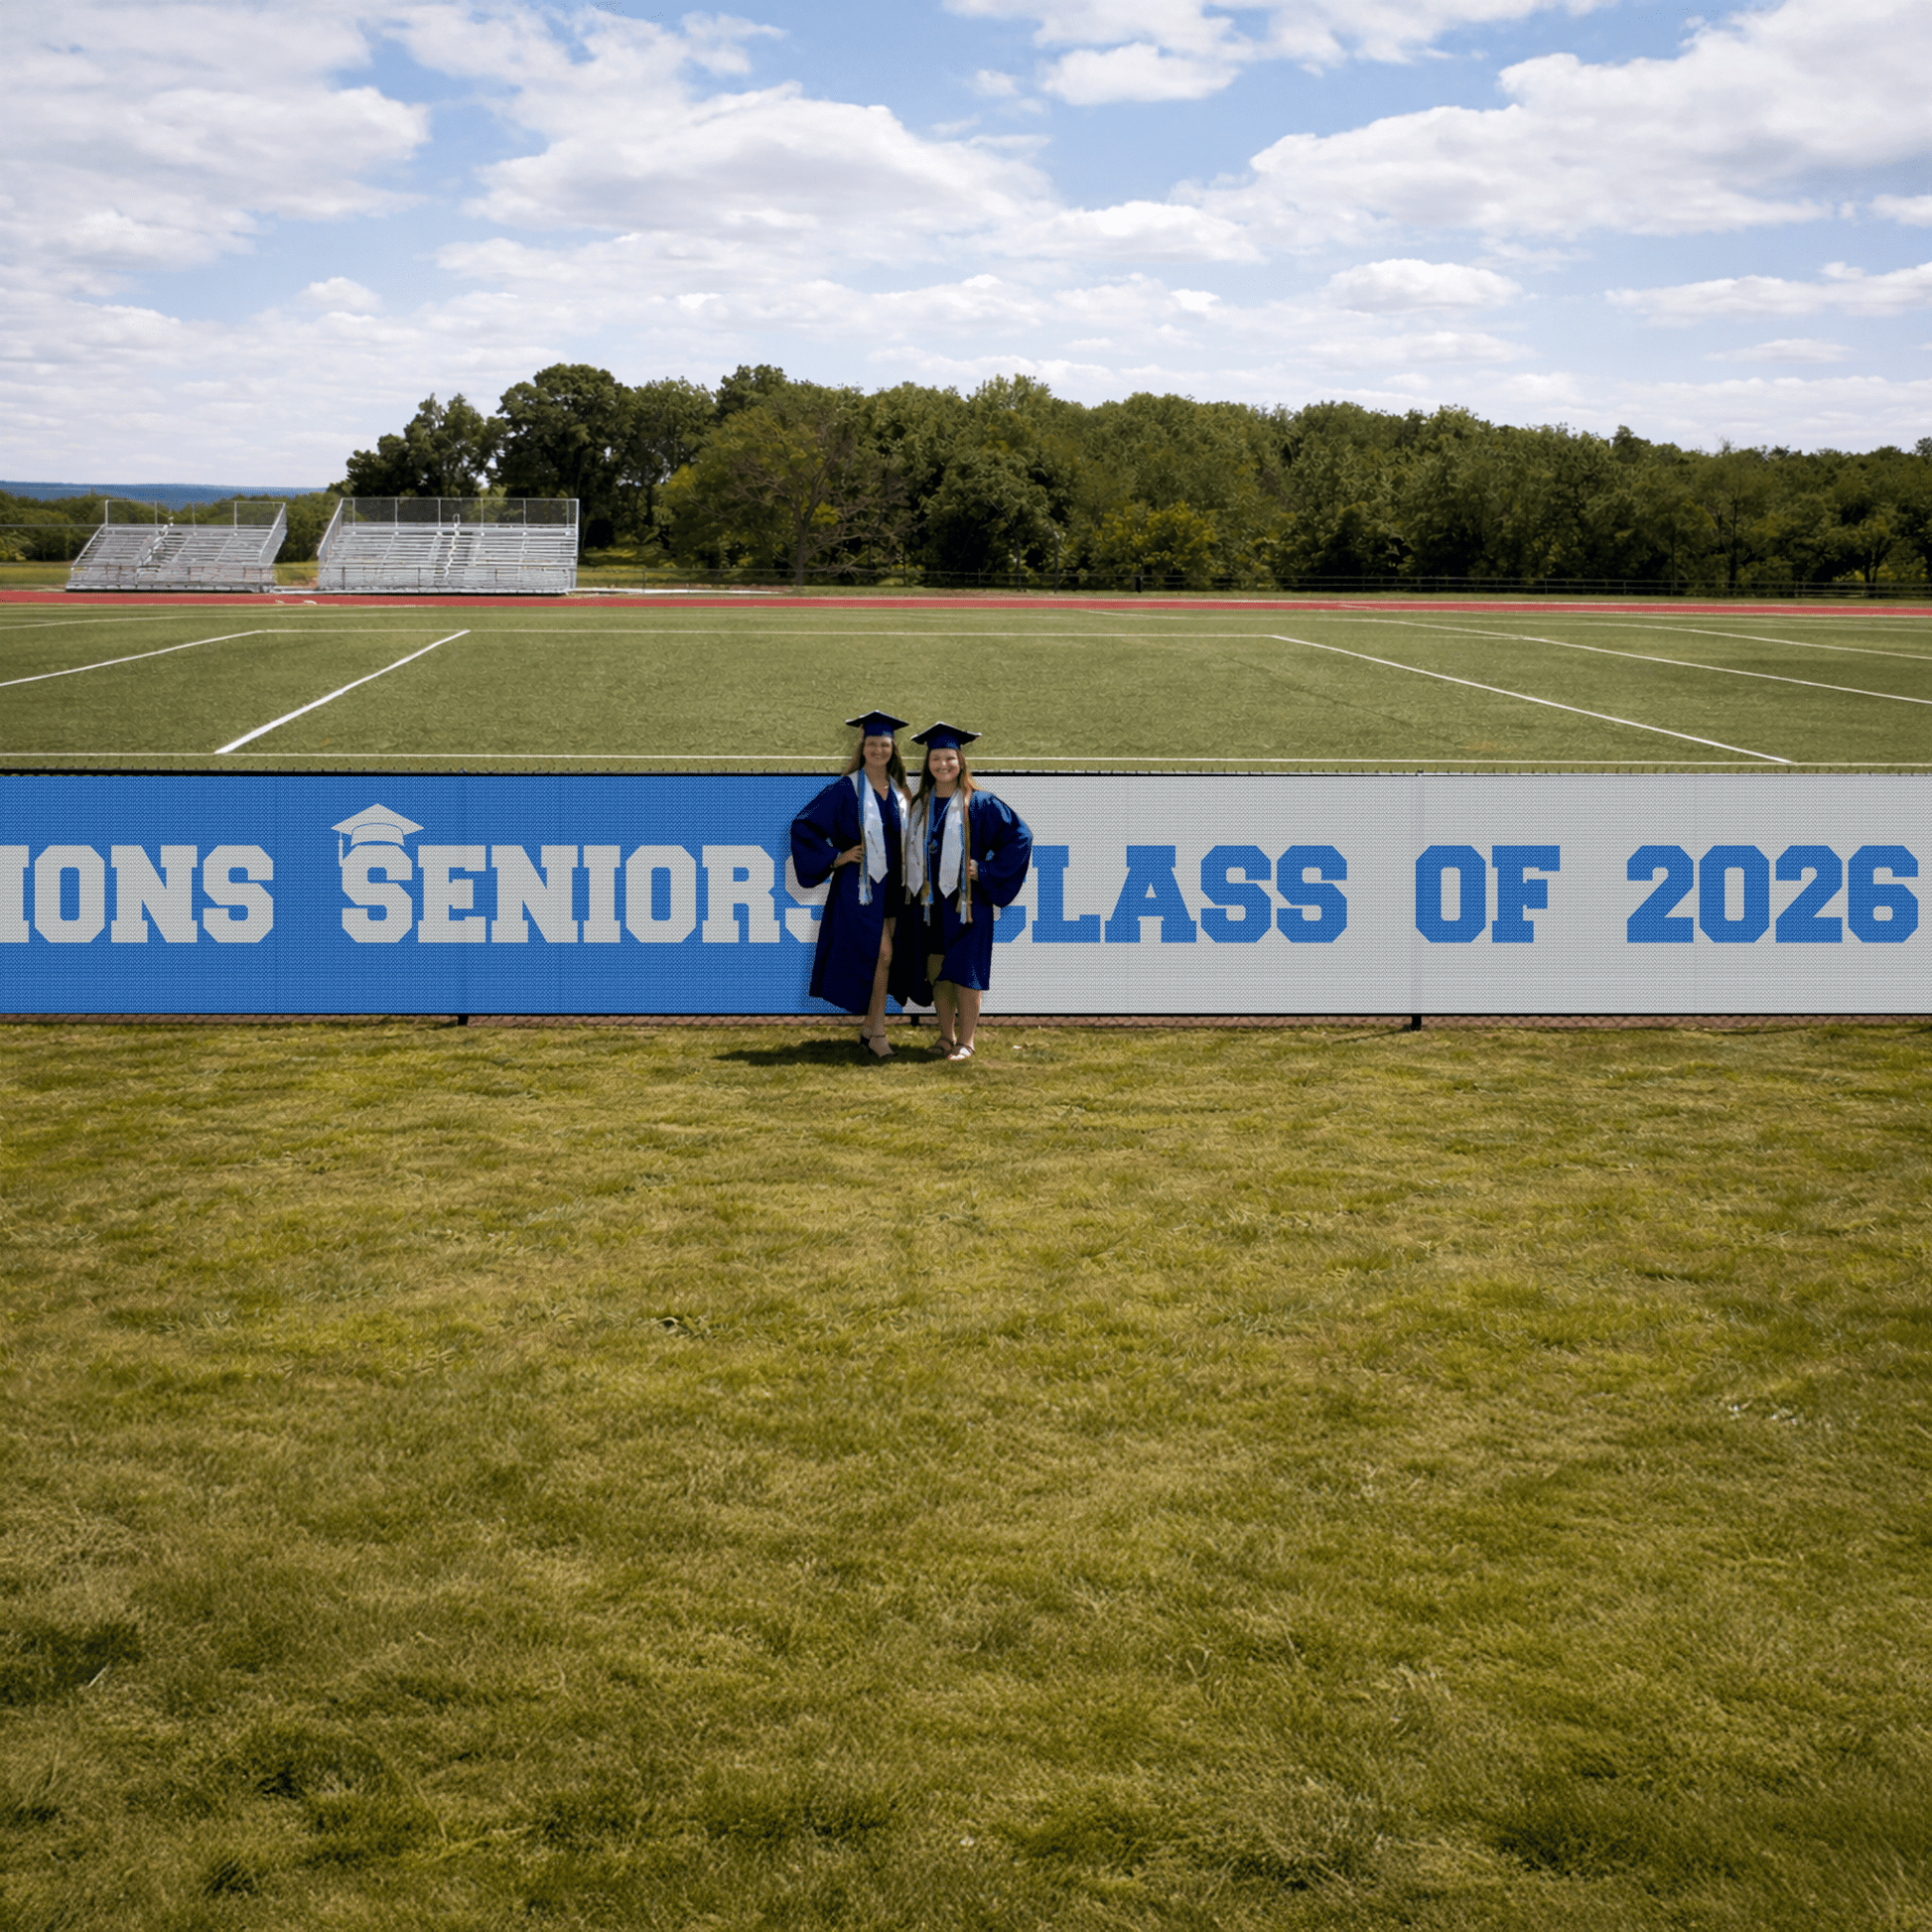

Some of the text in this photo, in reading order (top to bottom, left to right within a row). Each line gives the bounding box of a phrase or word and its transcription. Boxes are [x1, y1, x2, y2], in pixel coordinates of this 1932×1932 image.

[993, 845, 1347, 943] LASS
[1415, 845, 1561, 943] OF
[1626, 845, 1919, 943] 2026
